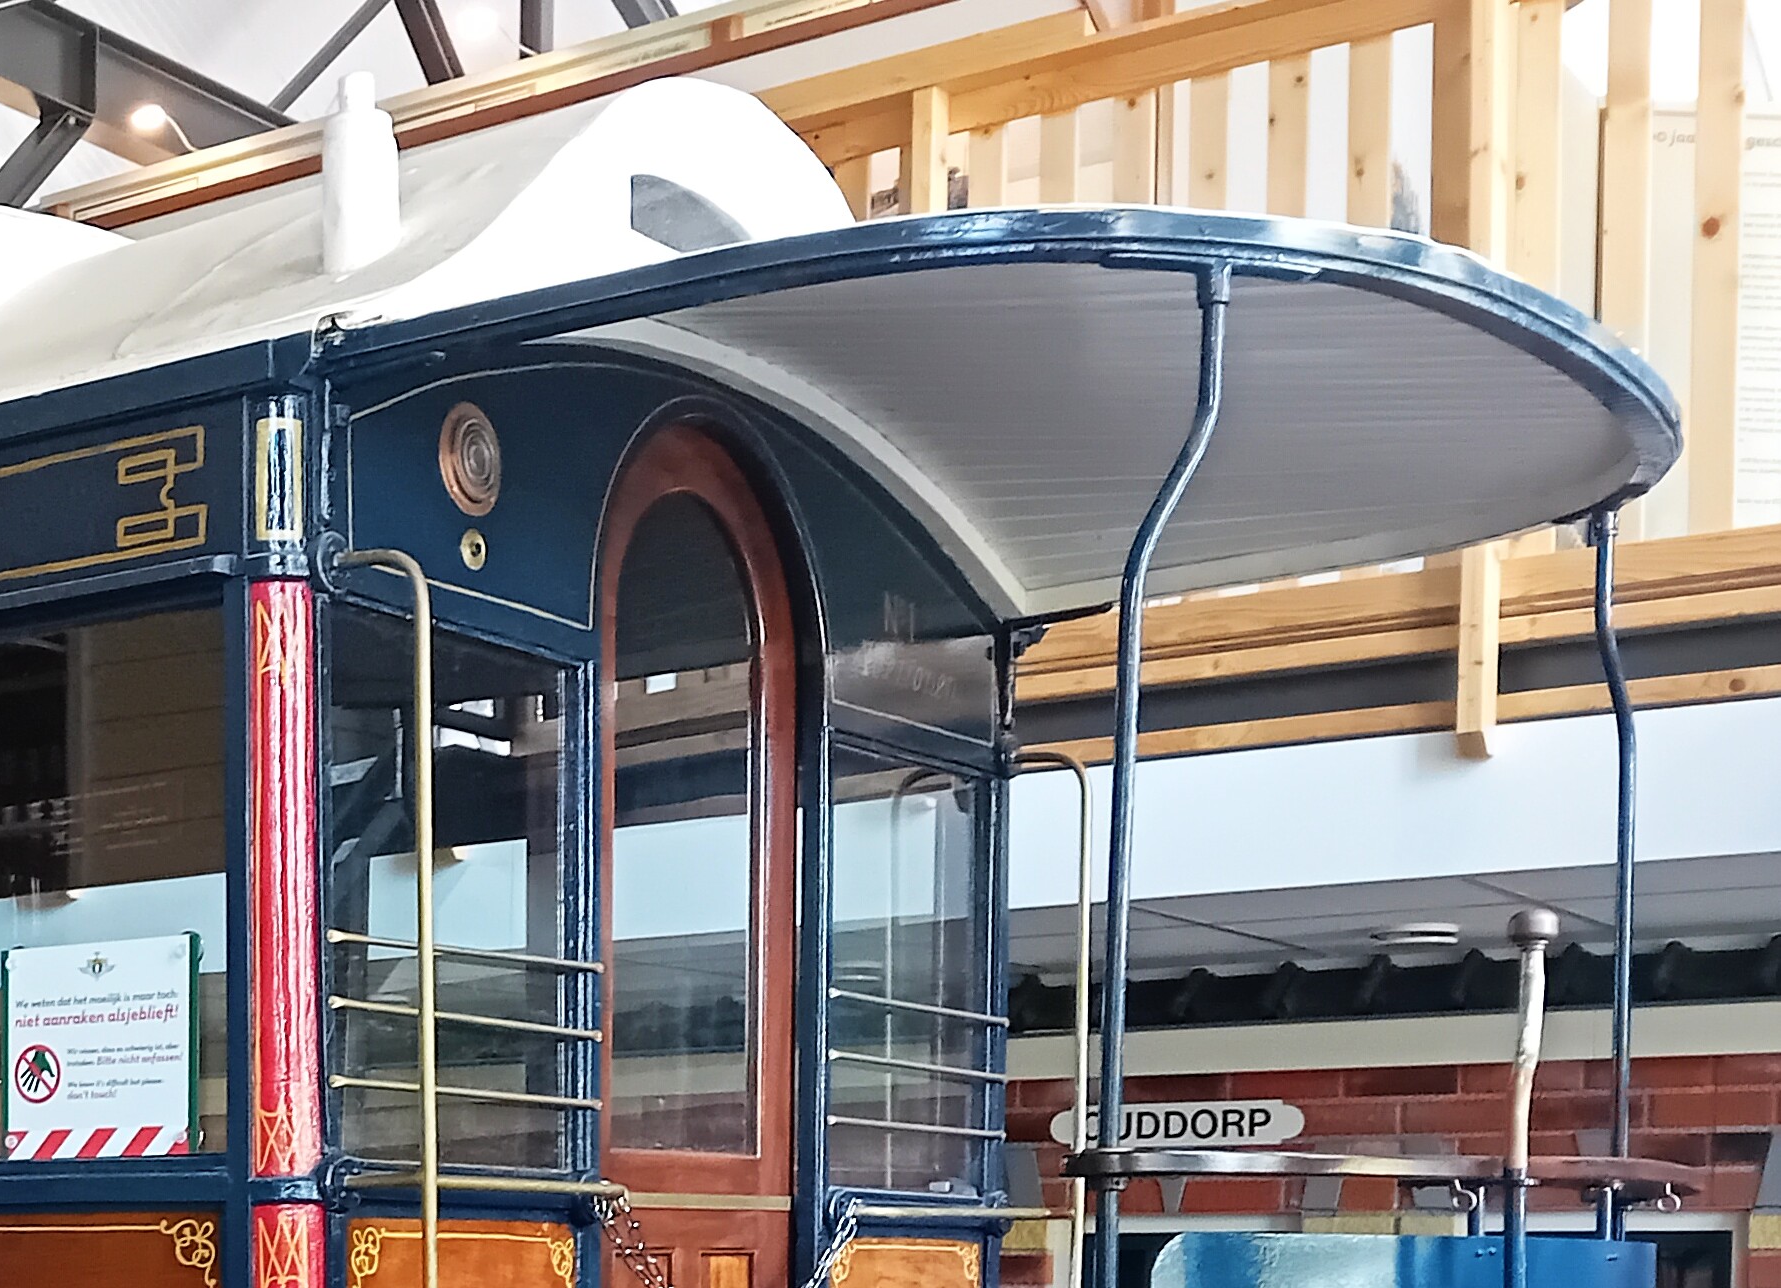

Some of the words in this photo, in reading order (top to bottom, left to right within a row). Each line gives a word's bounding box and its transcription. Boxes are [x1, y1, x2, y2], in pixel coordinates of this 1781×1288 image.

[1668, 129, 1696, 147] jaa
[57, 997, 71, 1006] dat
[73, 996, 87, 1005] het
[133, 992, 155, 1001] maar
[15, 1012, 39, 1028] niet
[43, 1009, 104, 1027] aanraken
[108, 1003, 179, 1025] alsjeblieft!
[118, 1054, 139, 1064] nicht
[141, 1052, 183, 1064] anfassen!
